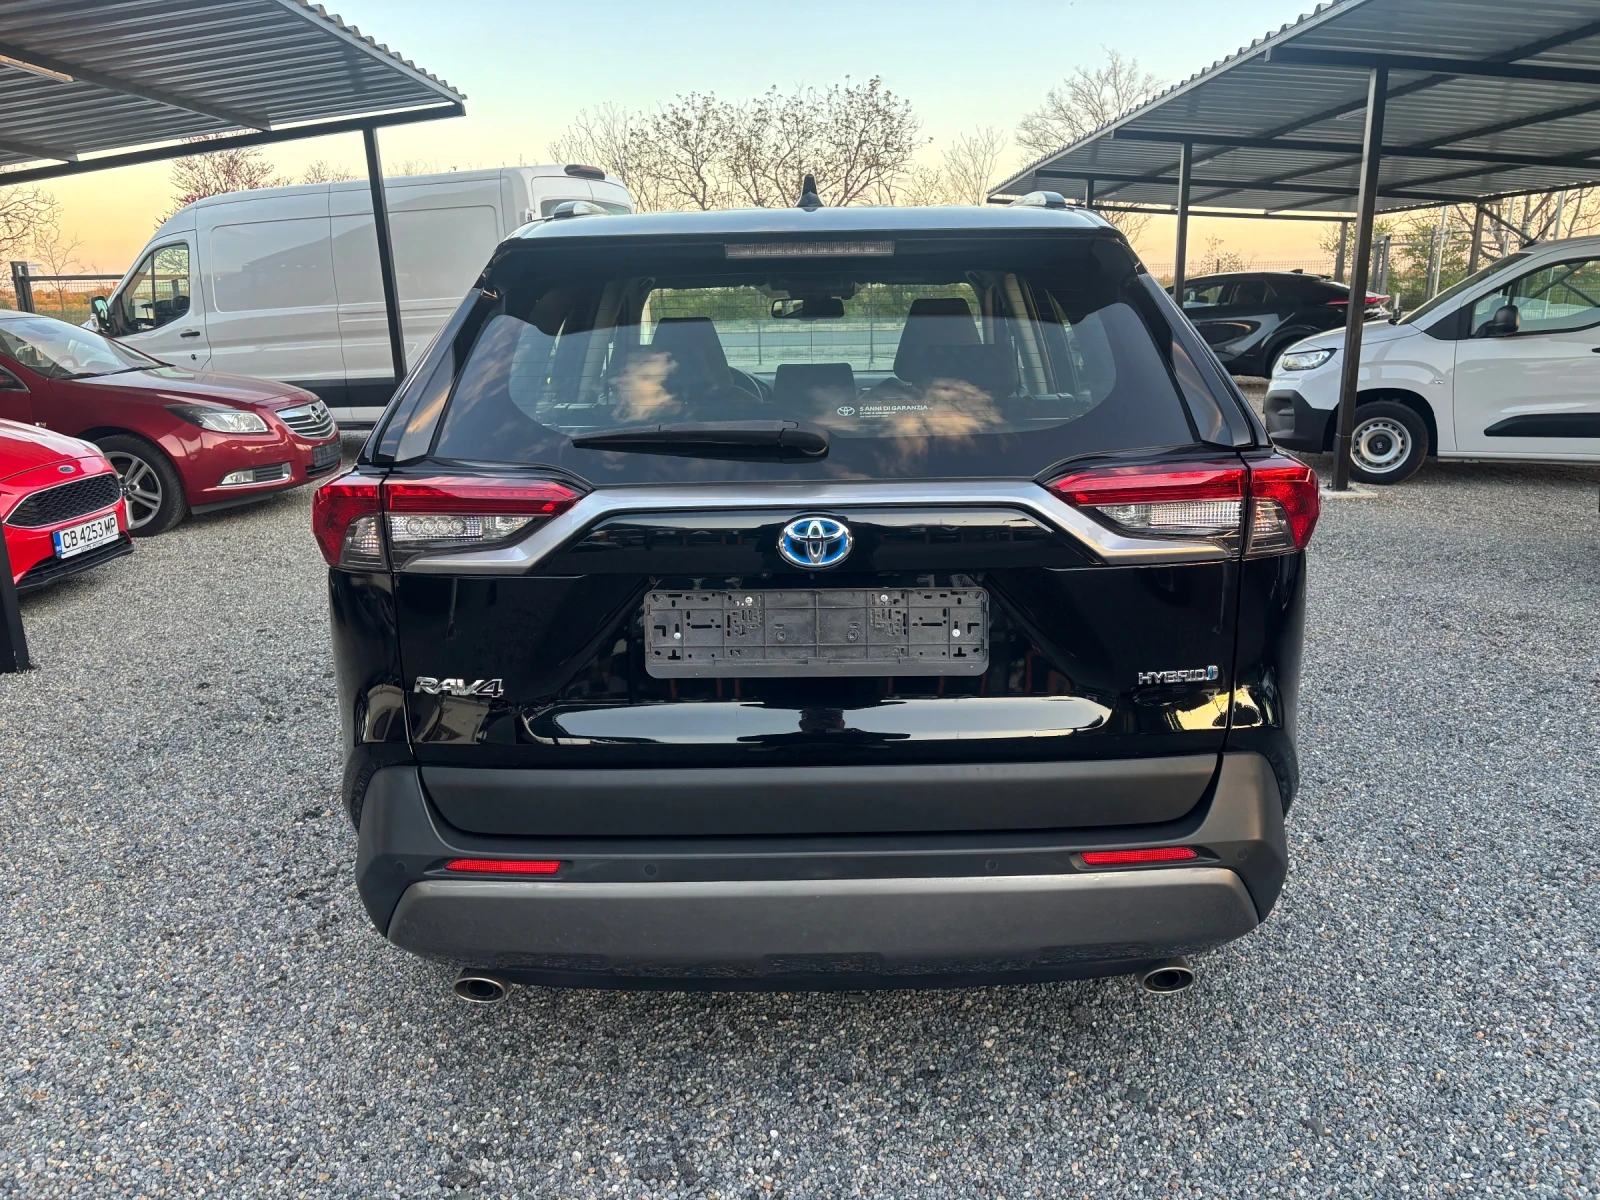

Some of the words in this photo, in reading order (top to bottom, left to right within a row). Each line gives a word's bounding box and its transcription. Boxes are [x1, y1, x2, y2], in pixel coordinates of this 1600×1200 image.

[62, 530, 79, 549] CB
[80, 521, 104, 543] 4253
[104, 517, 116, 536] MP
[413, 676, 504, 698] RAV4
[1138, 668, 1207, 685] HYBRID
